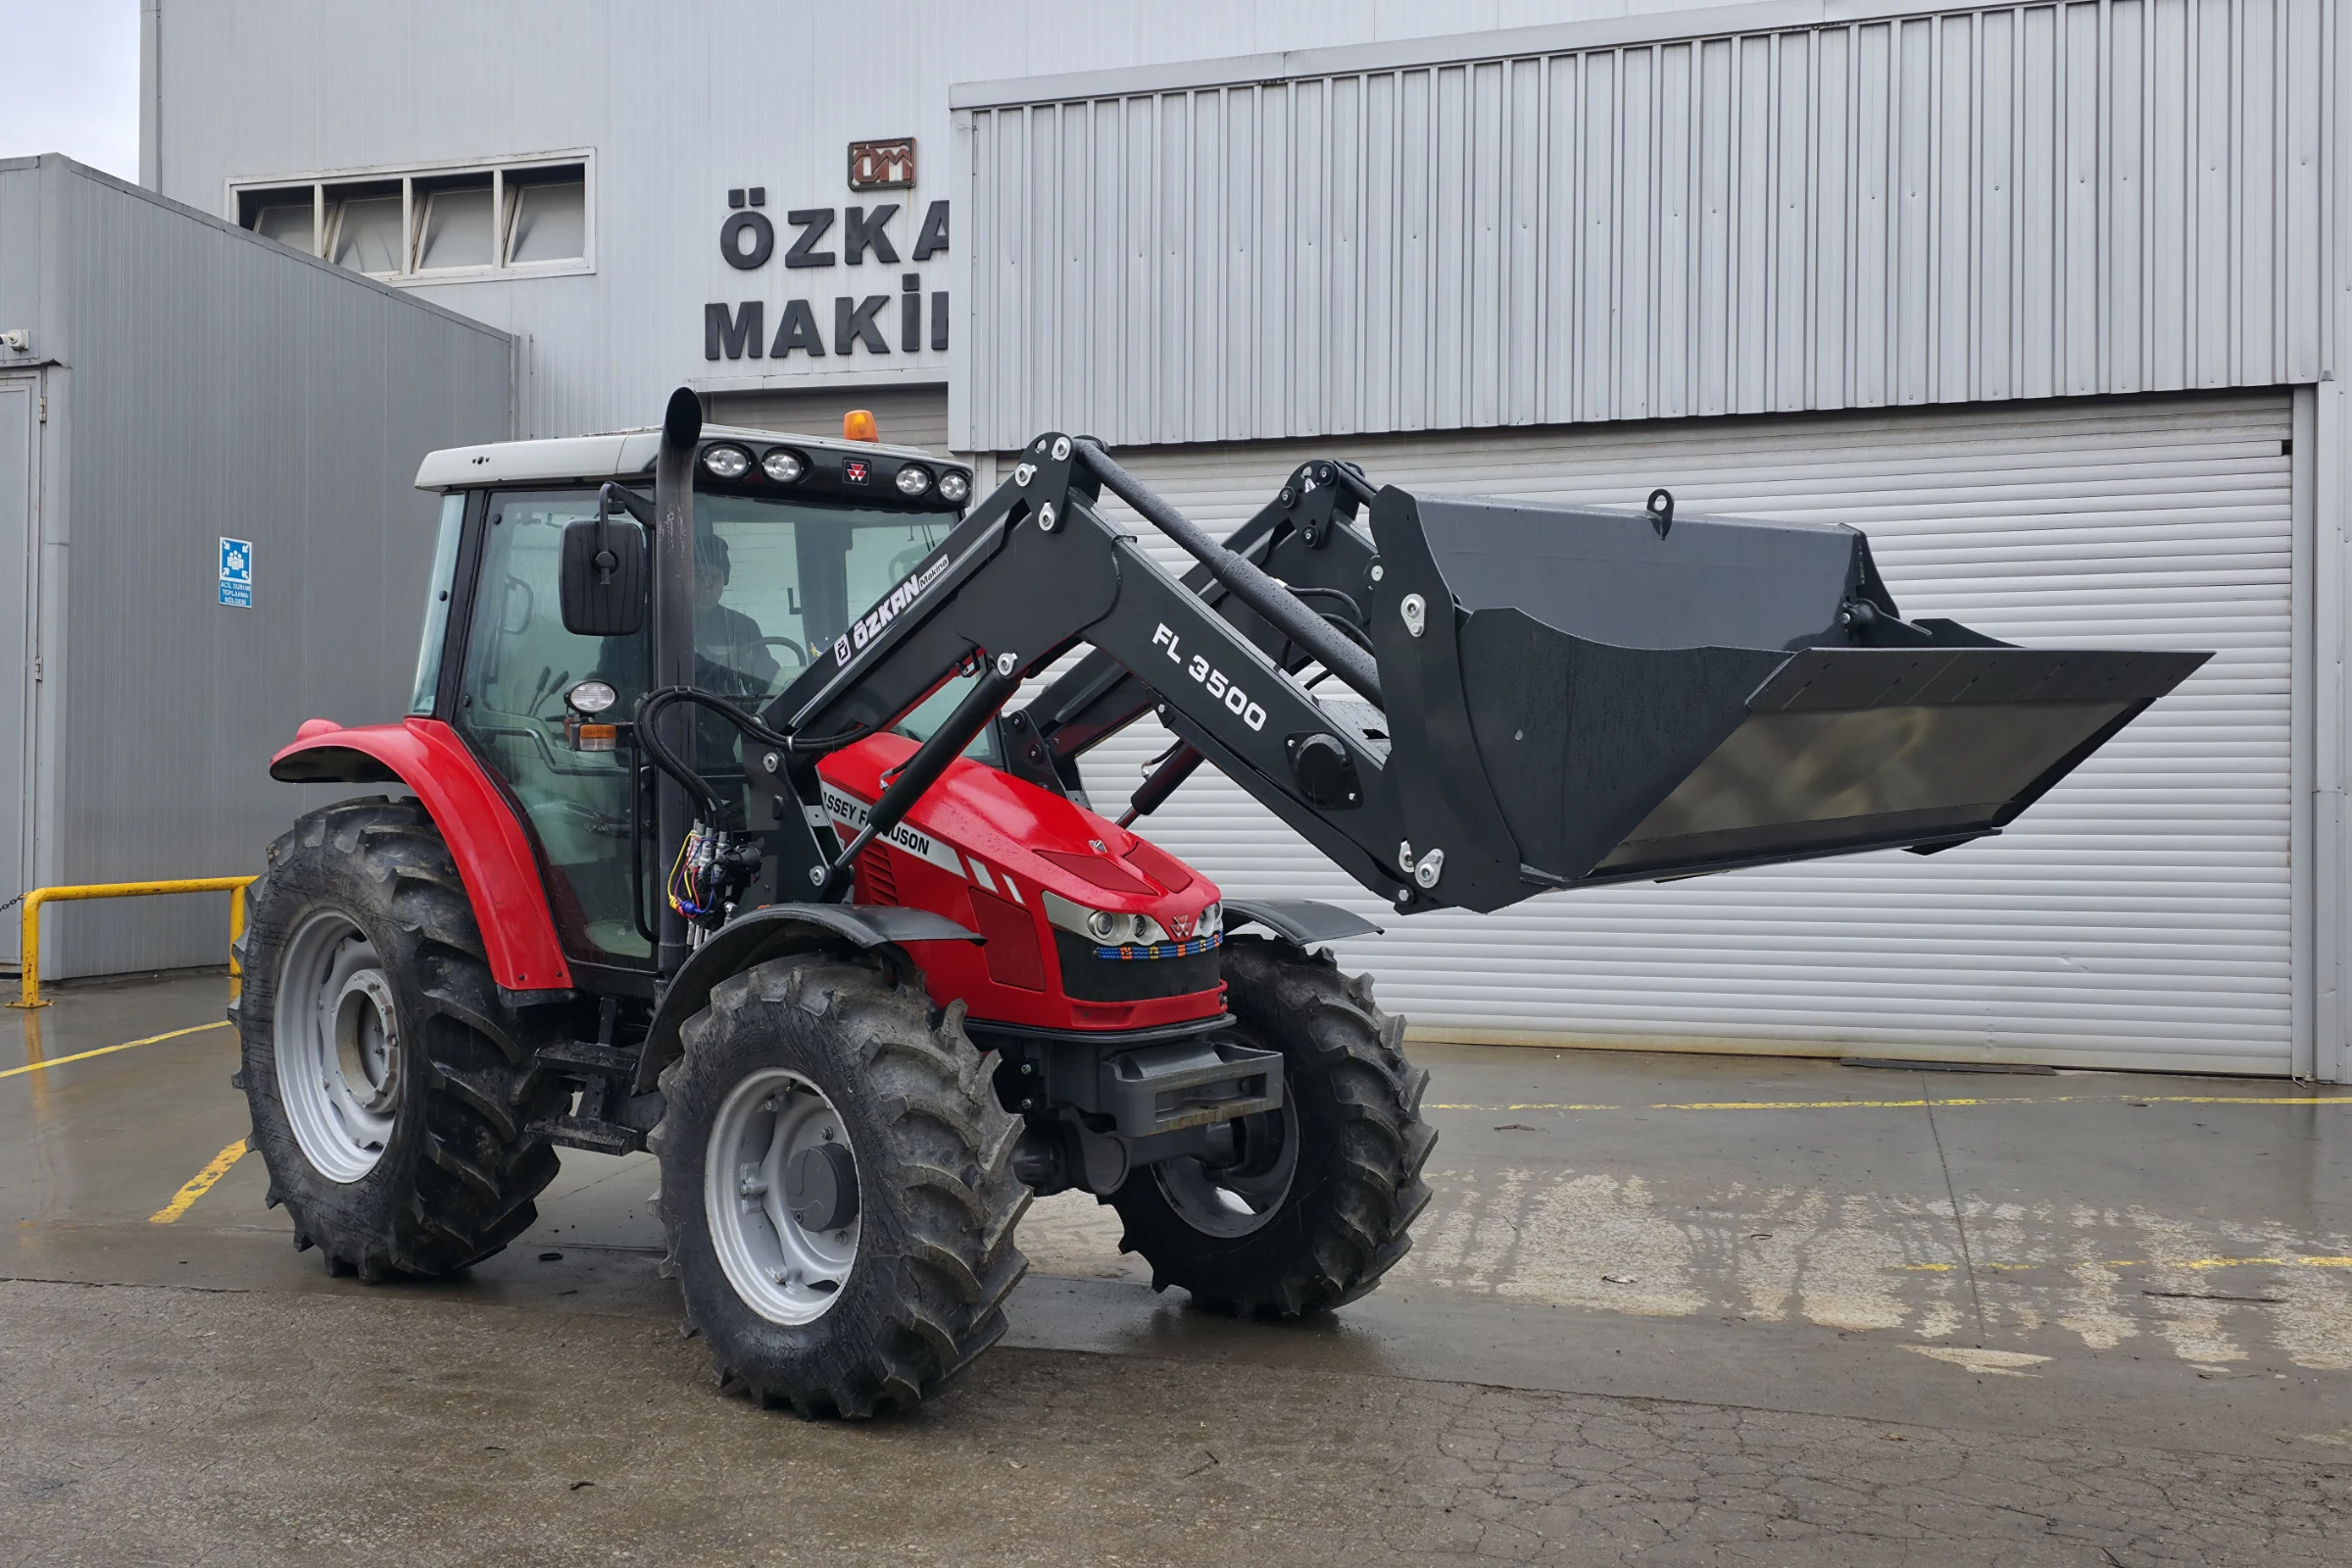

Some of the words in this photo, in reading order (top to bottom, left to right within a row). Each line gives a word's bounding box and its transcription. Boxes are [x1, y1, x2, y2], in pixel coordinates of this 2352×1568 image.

[853, 574, 920, 649] ÖZKAN
[919, 558, 949, 588] Makina
[1152, 622, 1181, 664] FL
[1188, 655, 1267, 732] 3500
[824, 792, 858, 820] SSEY
[858, 808, 930, 856] FUSON
